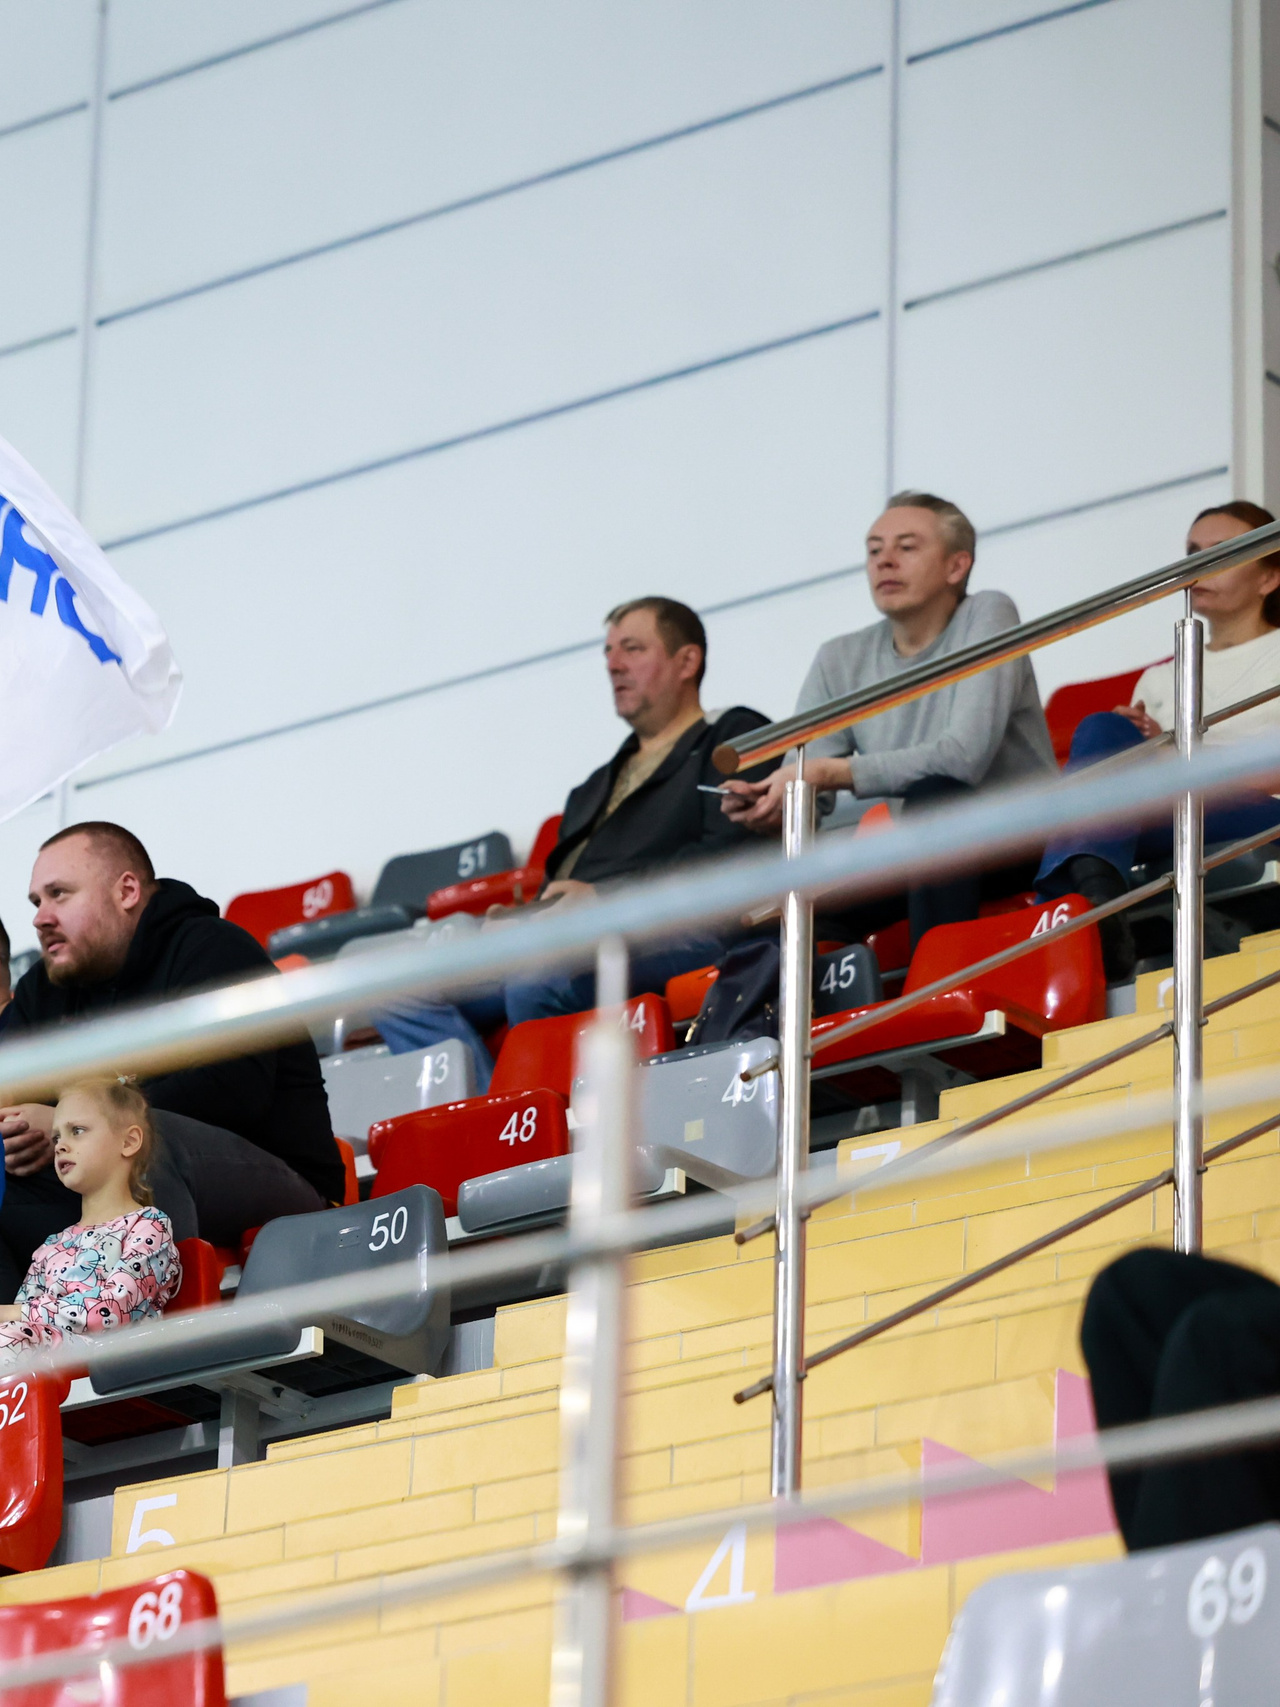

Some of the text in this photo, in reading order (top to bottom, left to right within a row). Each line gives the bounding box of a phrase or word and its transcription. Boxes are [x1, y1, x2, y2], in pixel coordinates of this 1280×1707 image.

[457, 840, 487, 878] 51
[302, 879, 334, 919] 50
[1030, 903, 1071, 939] 46
[820, 953, 856, 994] 45
[416, 1052, 449, 1088] 43
[721, 1068, 759, 1107] 49
[499, 1106, 537, 1146] 48
[369, 1206, 408, 1251] 50
[685, 1519, 755, 1612] 4
[1187, 1546, 1267, 1638] 69
[128, 1582, 183, 1650] 68
